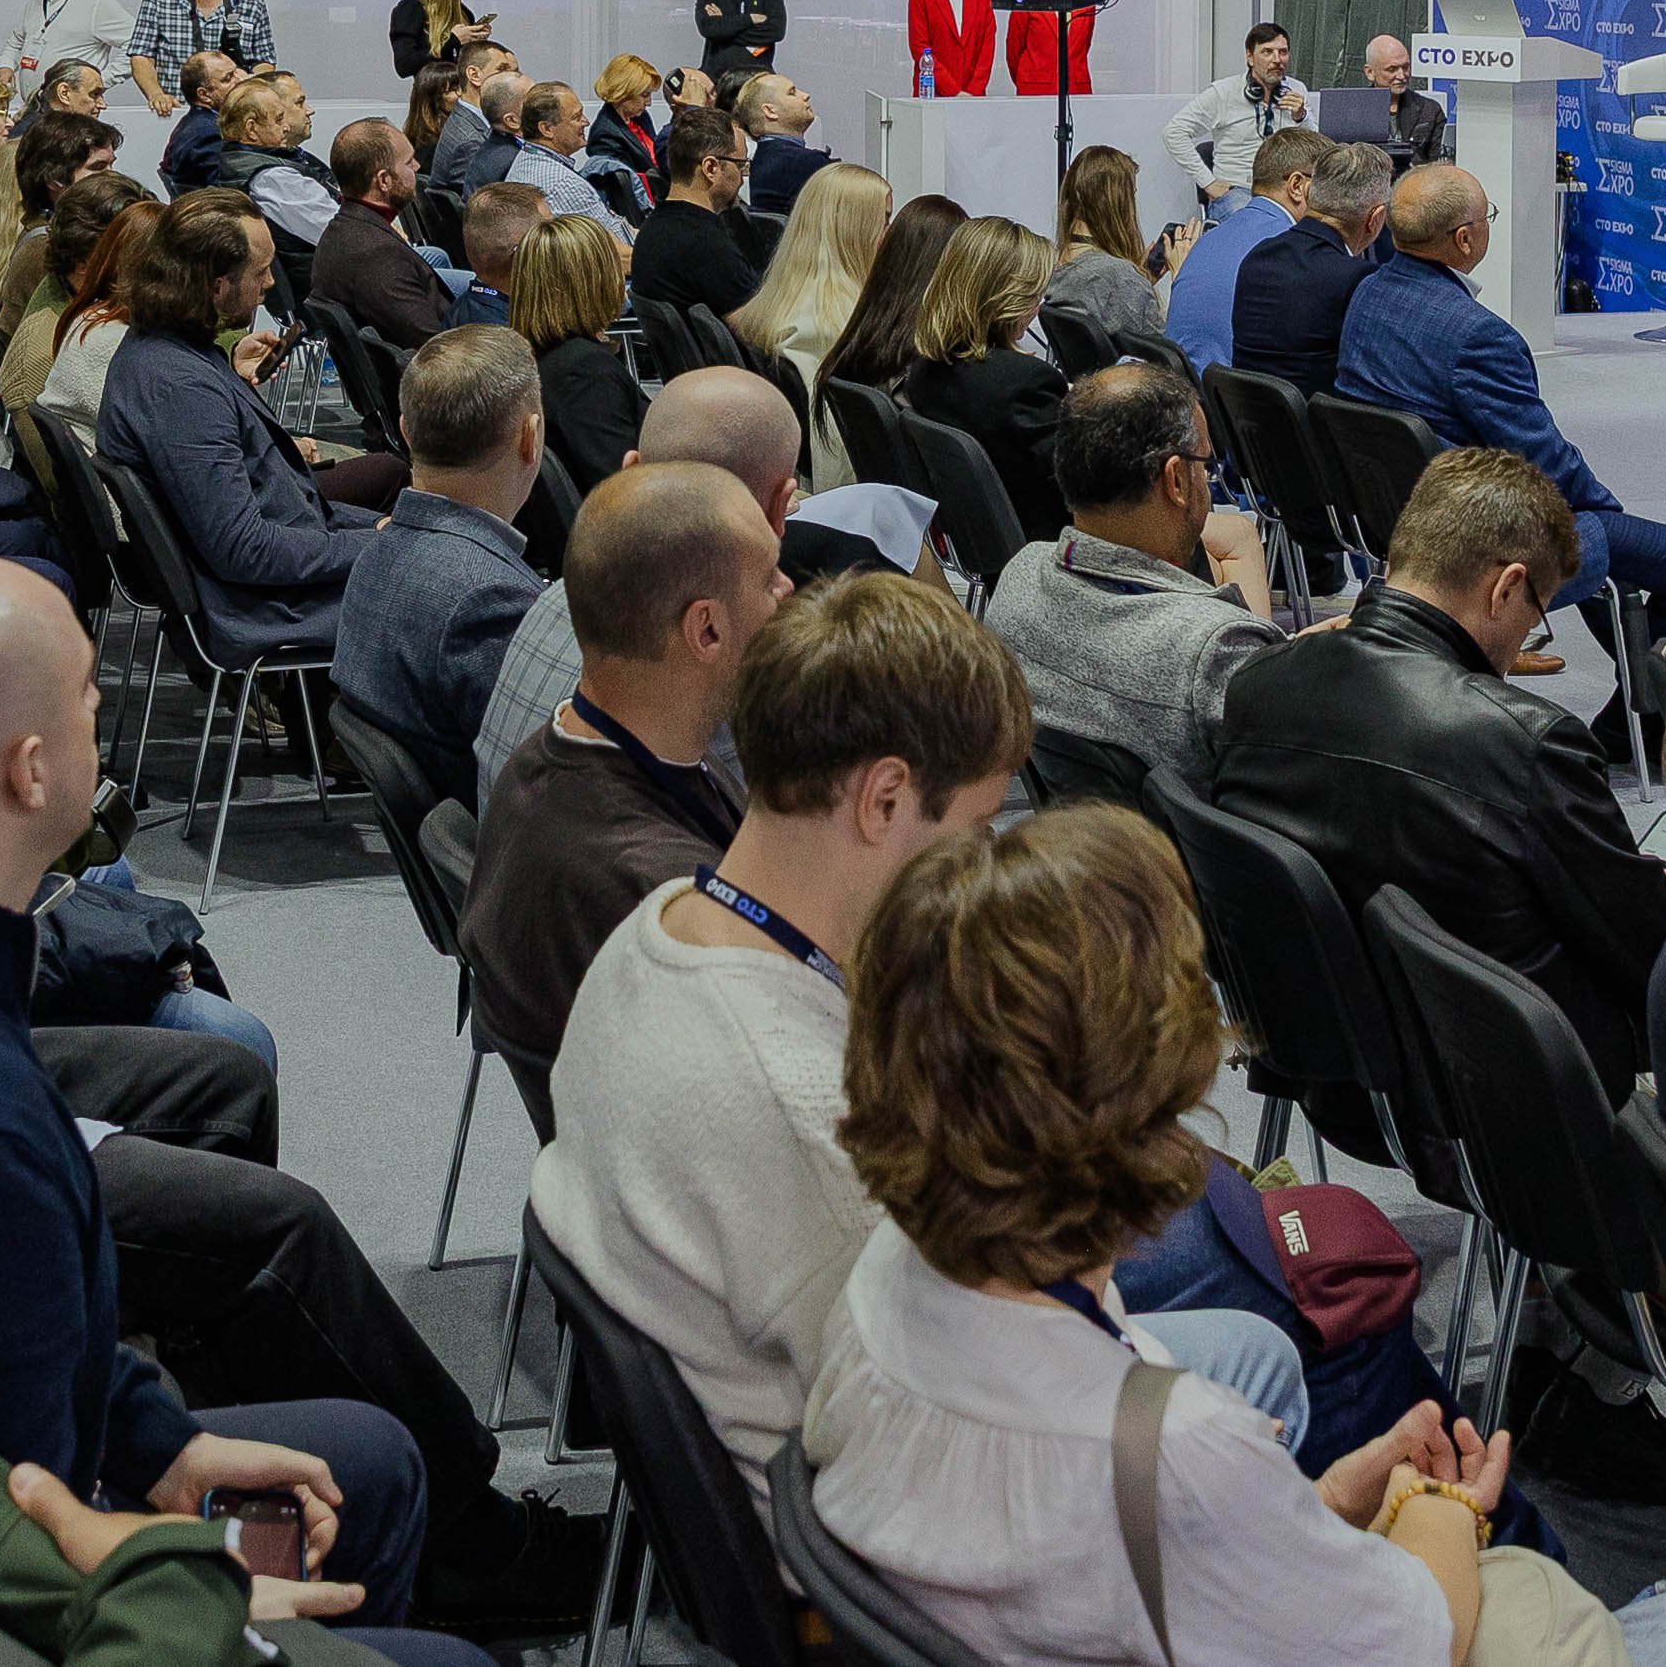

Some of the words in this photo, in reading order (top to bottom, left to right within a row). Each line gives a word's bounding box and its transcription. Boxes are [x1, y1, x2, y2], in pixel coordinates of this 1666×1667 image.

[1418, 47, 1456, 65] СТО
[1461, 49, 1514, 68] EXPO
[1278, 1209, 1310, 1256] VANS
